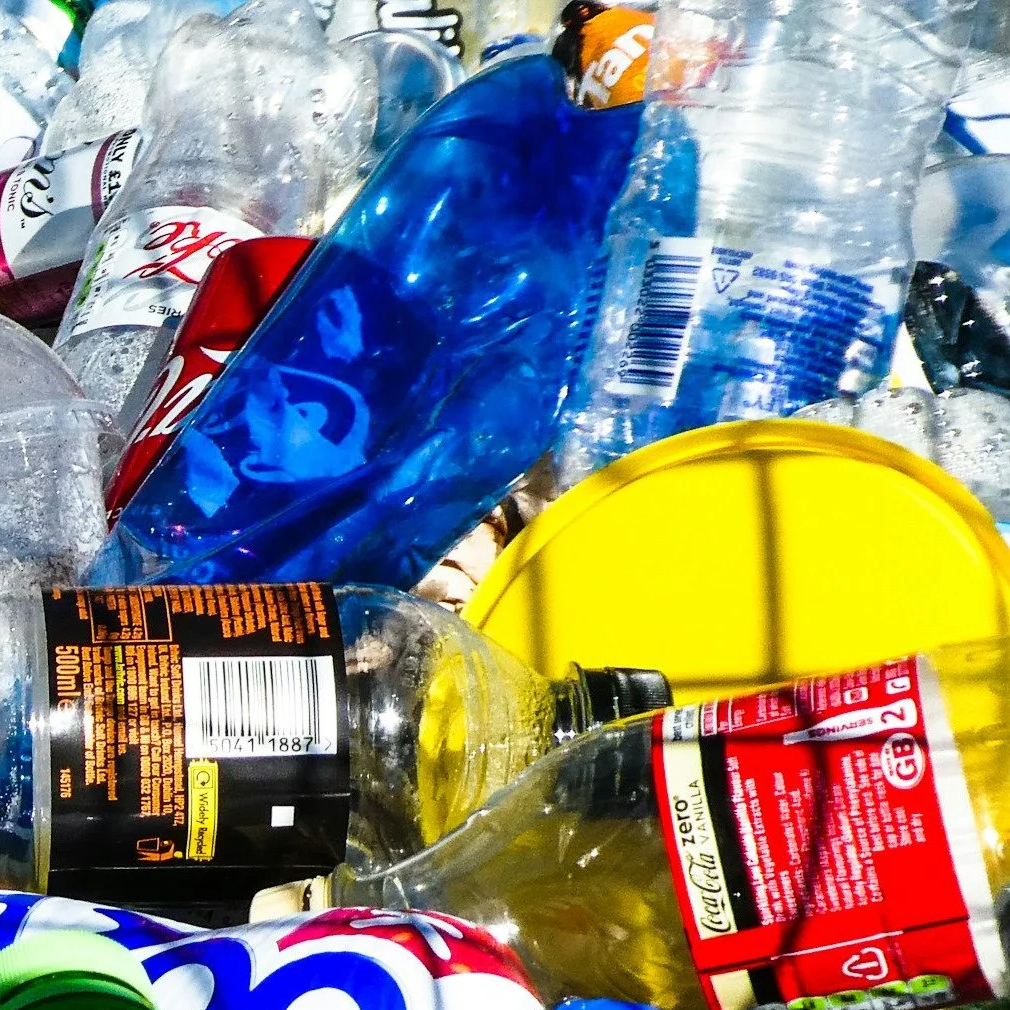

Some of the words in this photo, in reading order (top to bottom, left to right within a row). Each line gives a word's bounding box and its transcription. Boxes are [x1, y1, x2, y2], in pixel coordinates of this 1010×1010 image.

[580, 23, 655, 107] Tan
[55, 645, 81, 696] 500ml
[170, 664, 181, 678] Soft
[171, 680, 182, 703] Drinks
[268, 736, 314, 752] 1887
[890, 735, 918, 781] GB
[59, 768, 71, 798] 145176
[197, 792, 209, 825] Widely
[673, 797, 696, 846] zero
[687, 778, 710, 844] VANILLA
